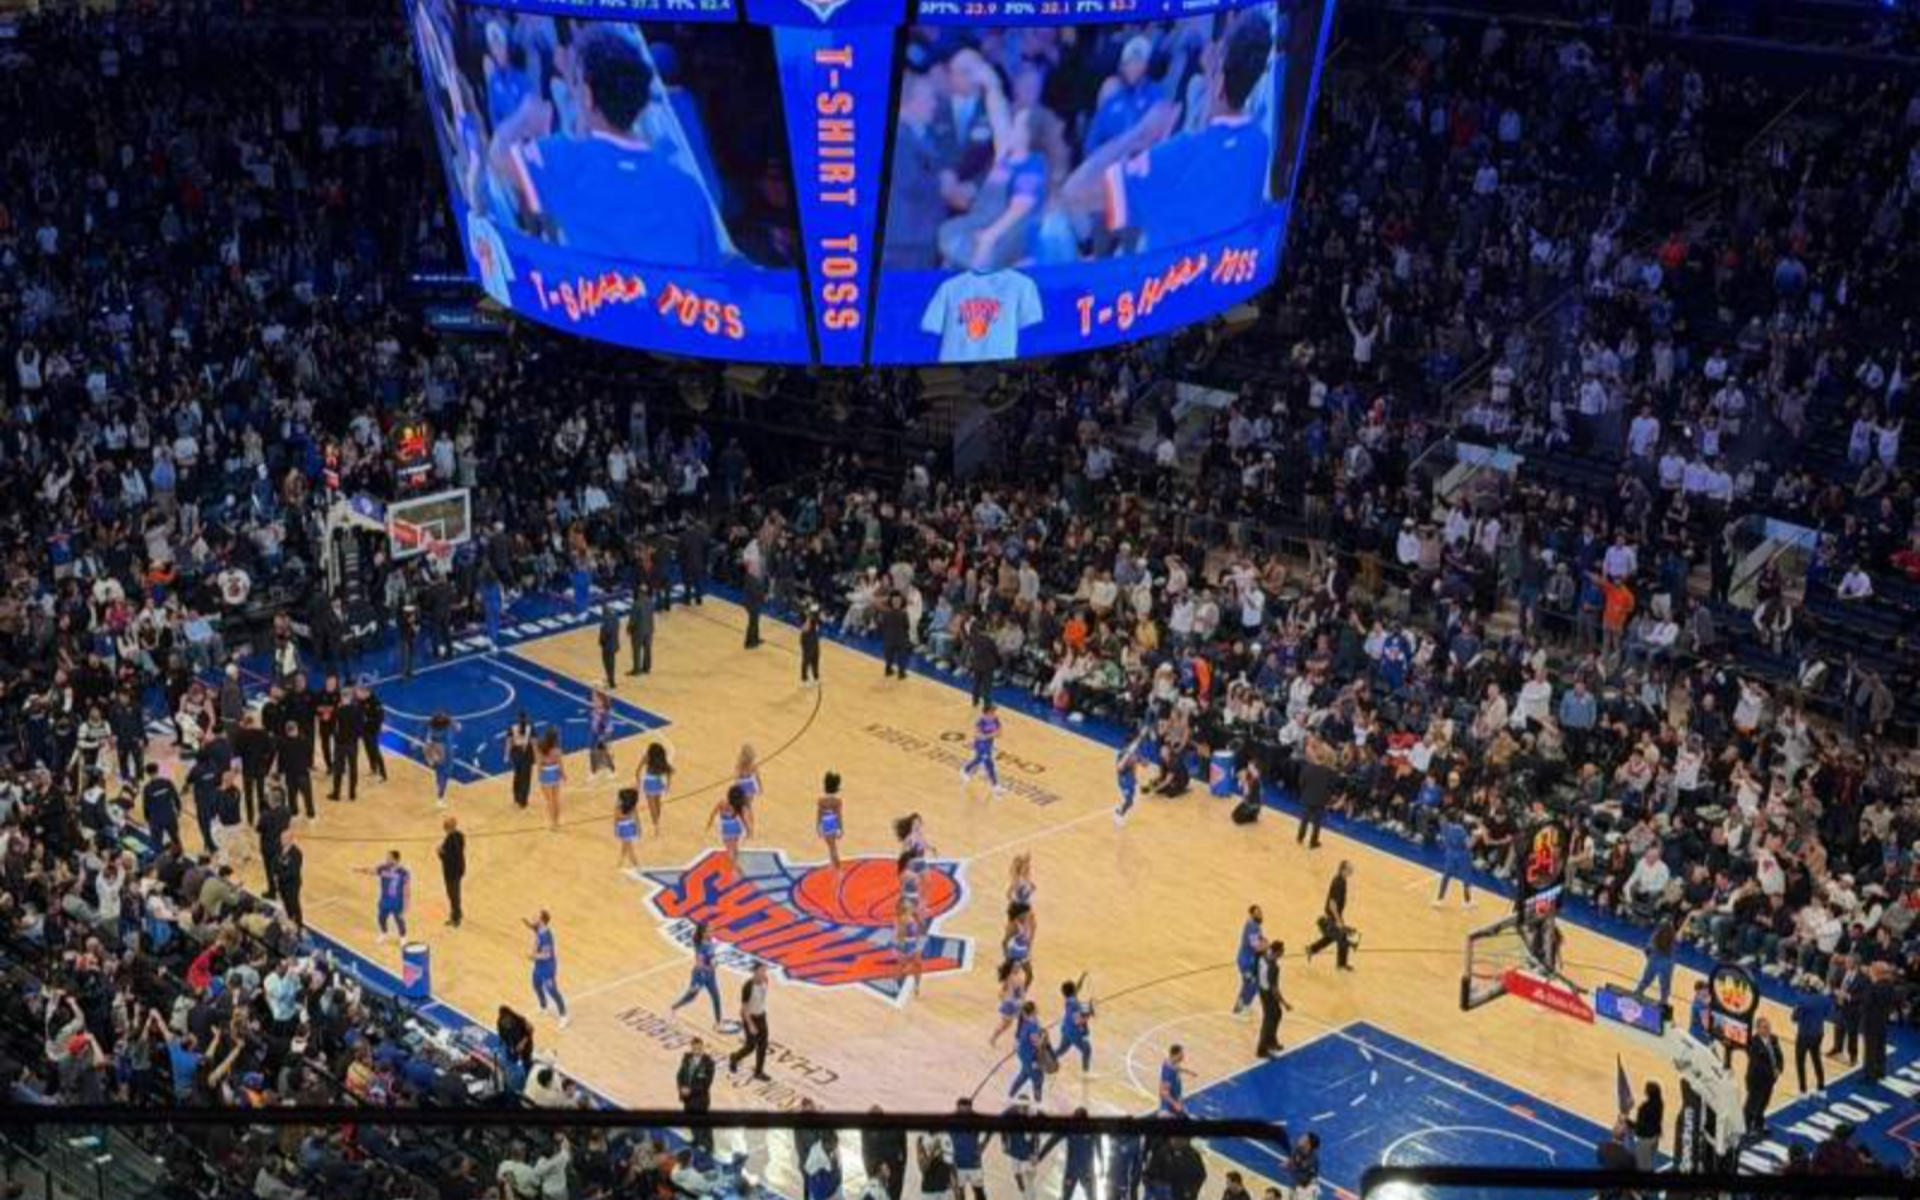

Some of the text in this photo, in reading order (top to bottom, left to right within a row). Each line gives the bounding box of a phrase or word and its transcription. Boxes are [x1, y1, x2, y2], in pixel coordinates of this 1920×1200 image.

[815, 45, 860, 329] T-SHIRT TOSS
[651, 848, 966, 987] KNICKS
[766, 1041, 840, 1086] CHAS
